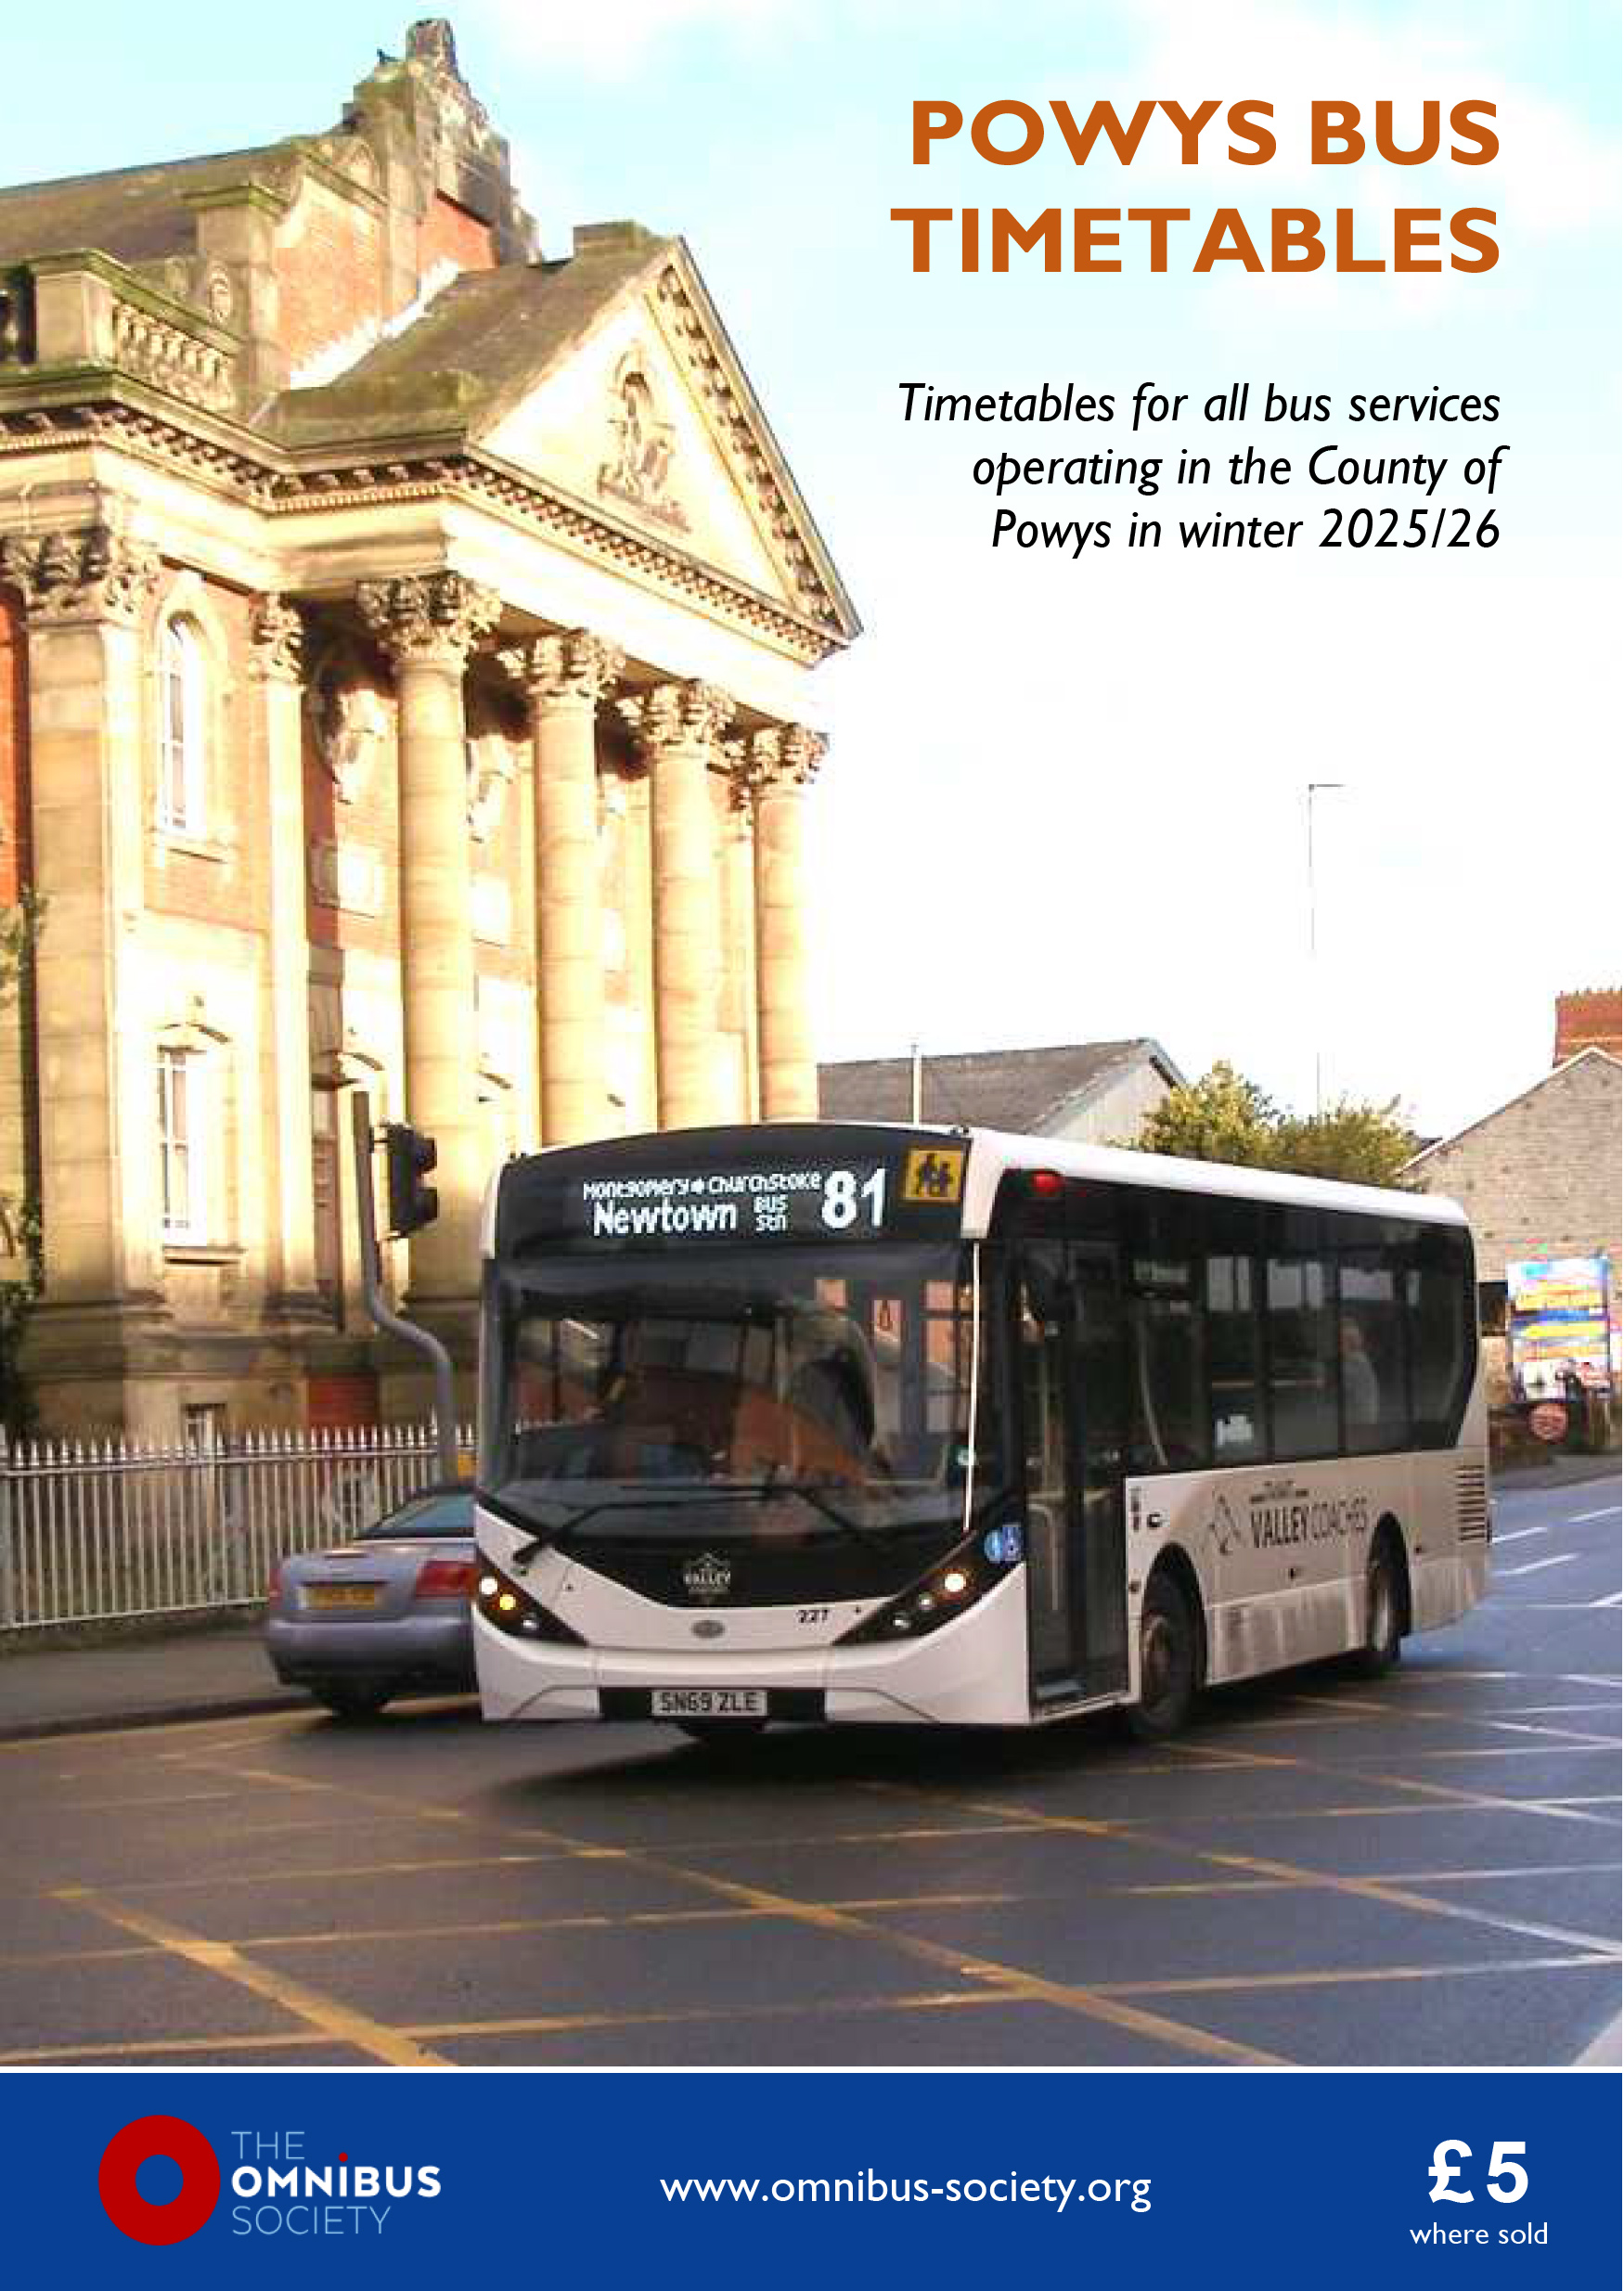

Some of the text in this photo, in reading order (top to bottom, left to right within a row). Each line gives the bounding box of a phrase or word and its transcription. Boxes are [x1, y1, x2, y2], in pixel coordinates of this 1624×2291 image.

[583, 1178, 690, 1199] Montgomery
[822, 1168, 885, 1229] 81
[594, 1198, 737, 1236] Newtown
[1251, 1505, 1308, 1548] VALLEY
[798, 1609, 829, 1624] 227
[660, 1693, 758, 1711] SN69 ZLE
